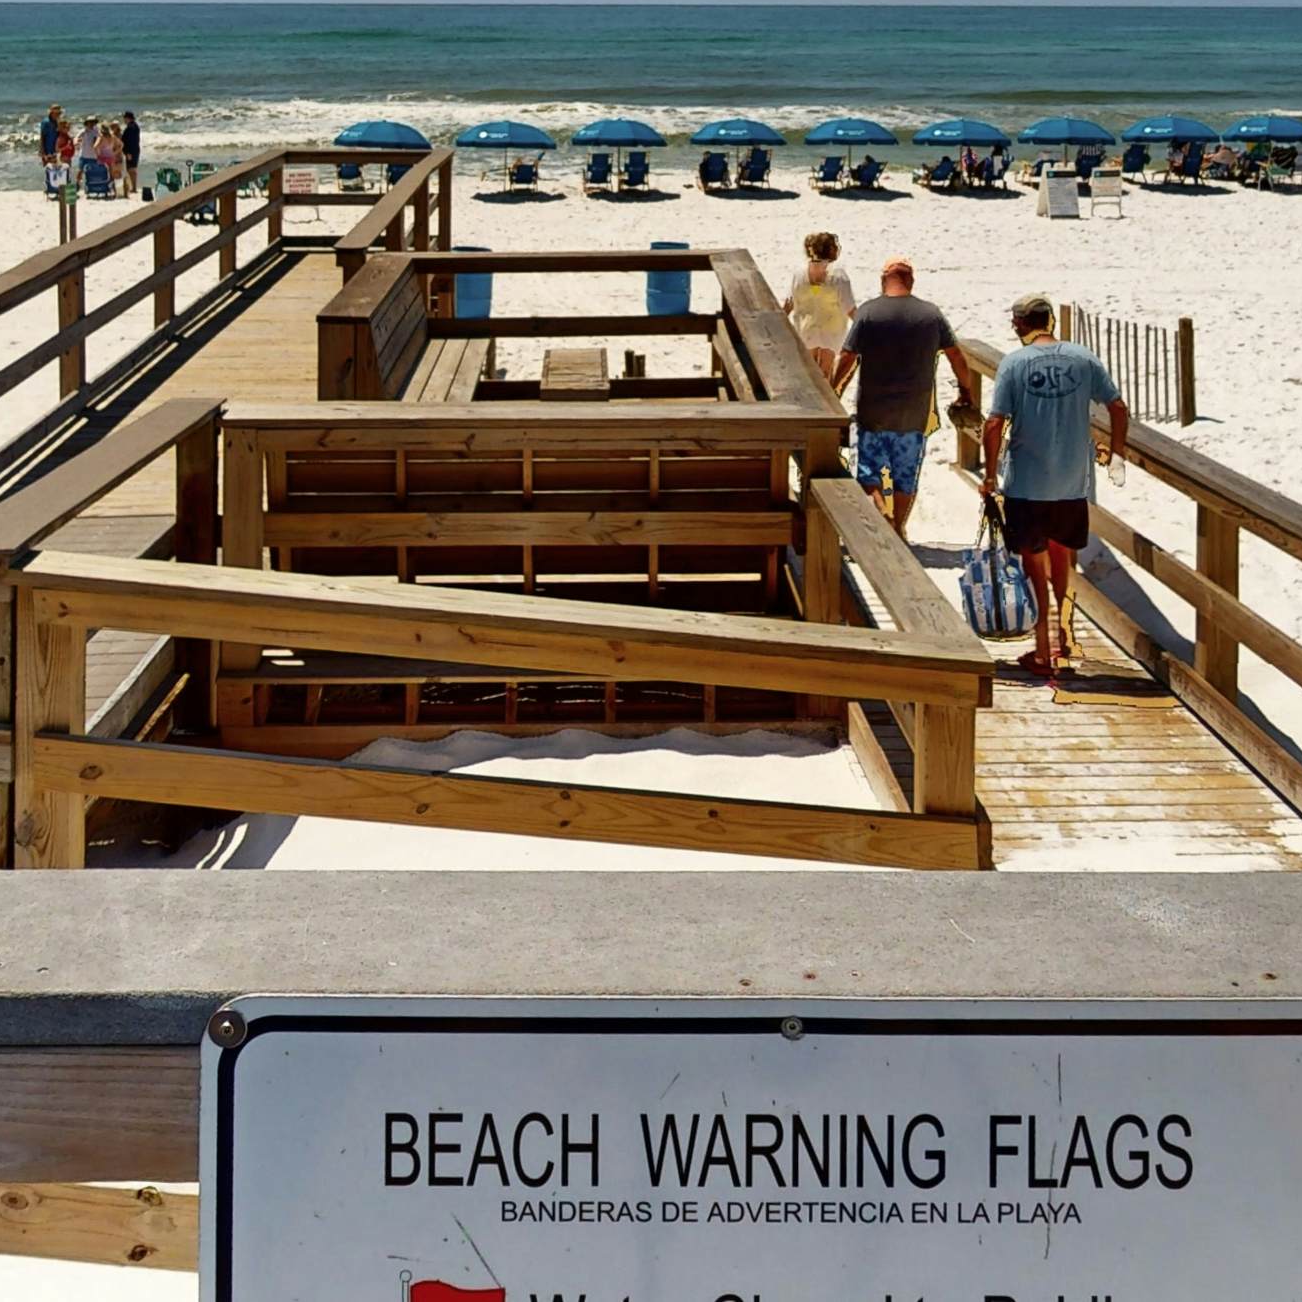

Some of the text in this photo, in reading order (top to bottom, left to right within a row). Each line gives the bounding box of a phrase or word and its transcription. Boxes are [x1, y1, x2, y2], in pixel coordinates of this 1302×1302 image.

[383, 1112, 1195, 1190] BEACH WARNING FLAGS
[500, 1200, 1083, 1226] BANDERAS DE ADVERTENCIA EN LA PLAYA
